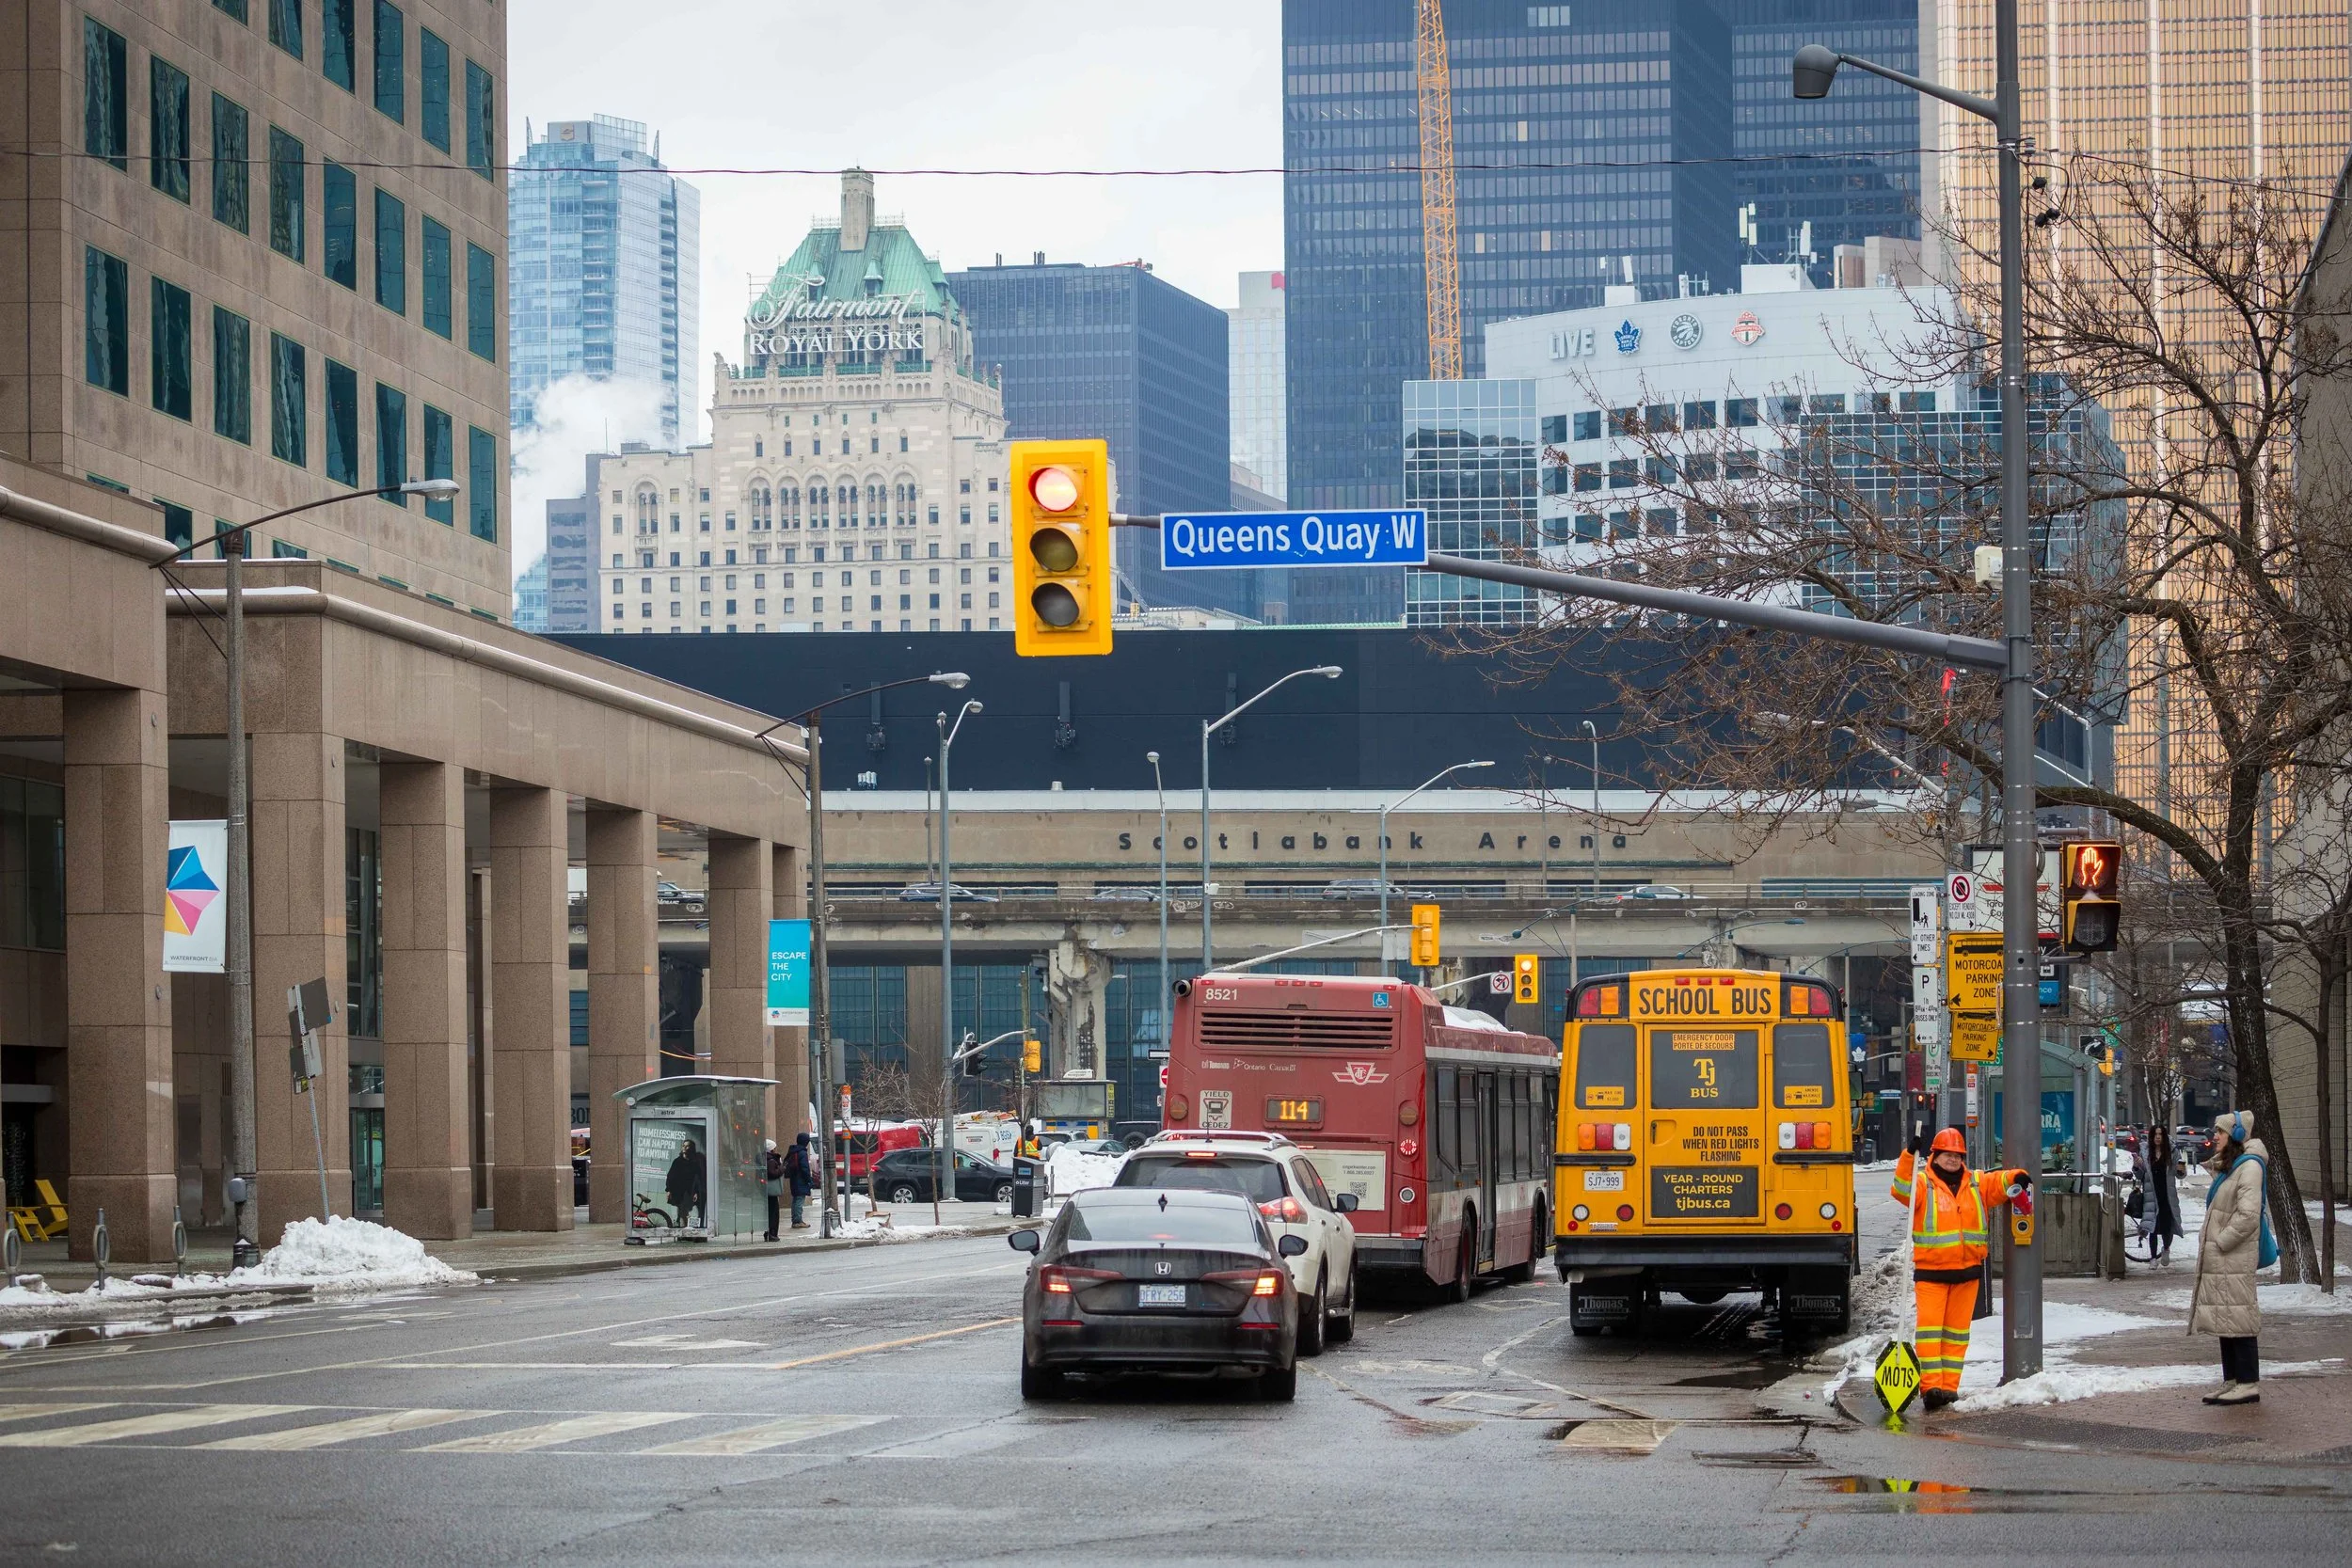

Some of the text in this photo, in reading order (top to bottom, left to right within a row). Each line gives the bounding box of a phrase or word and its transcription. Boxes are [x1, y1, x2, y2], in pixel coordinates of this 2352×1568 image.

[747, 274, 918, 330] Fairmont
[750, 328, 923, 355] ROYAL YORK
[1549, 328, 1595, 359] LIVE
[1172, 515, 1417, 559] Queens Quay W
[1119, 831, 1627, 849] Scotiabank Arena
[1955, 959, 2003, 970] MOTORCOA
[1922, 974, 1930, 989] P
[1966, 974, 2003, 984] PARKING
[1205, 990, 1237, 1001] 8521
[1973, 988, 1996, 997] ZONE
[1639, 988, 1772, 1015] SCHOOL BUS
[1963, 1033, 1987, 1041] PARKING
[1690, 1087, 1719, 1098] BUS
[1279, 1101, 1309, 1120] 114
[639, 1127, 686, 1140] HOMELESSNESS
[1693, 1126, 1748, 1136] DO NOT PASS
[638, 1137, 676, 1149] CAN HAPPEN
[1682, 1138, 1759, 1148] WHEN RED LIGHTS
[637, 1148, 670, 1160] TO ANYONE
[1700, 1151, 1741, 1162] FLASHING
[1663, 1175, 1693, 1183] YEAR
[1702, 1175, 1743, 1183] ROUND
[1674, 1185, 1733, 1195] CHARTERS
[1676, 1196, 1731, 1211] tjbus.ca
[1582, 1296, 1624, 1308] Thomas
[1794, 1295, 1836, 1307] Thomas
[1882, 1365, 1914, 1388] SLOW
